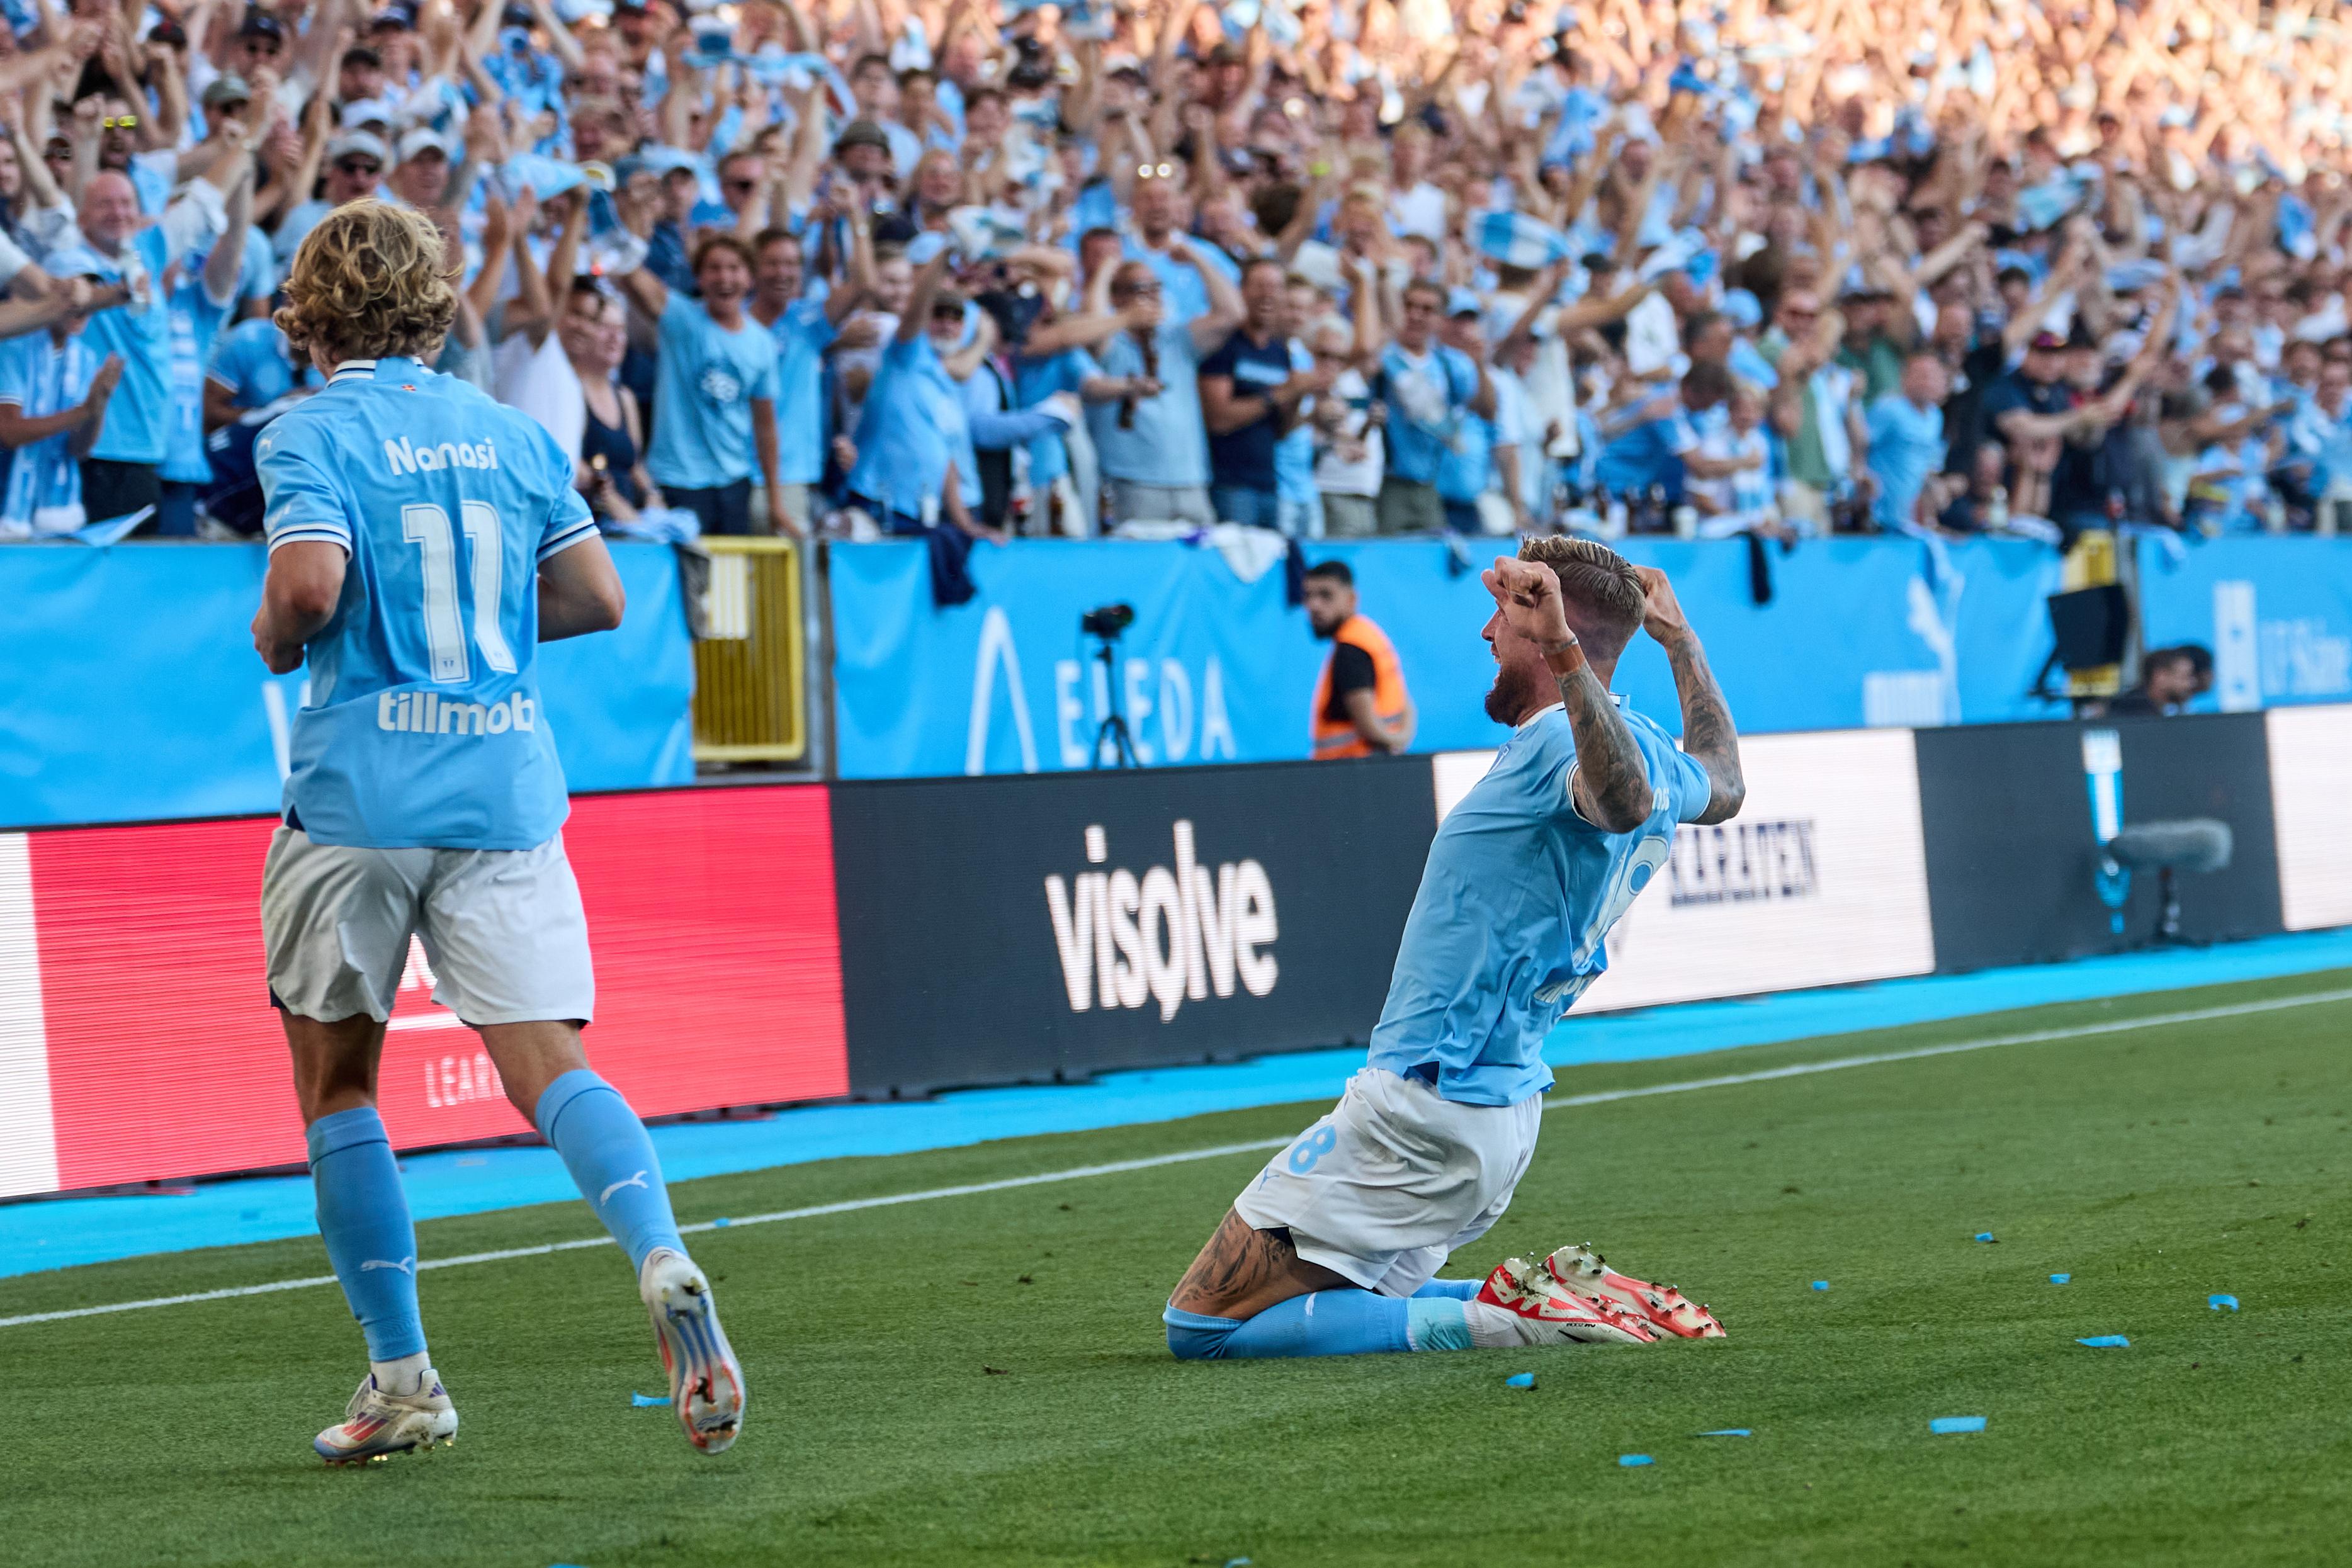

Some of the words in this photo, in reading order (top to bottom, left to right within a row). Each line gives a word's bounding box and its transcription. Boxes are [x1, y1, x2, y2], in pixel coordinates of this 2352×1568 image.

[384, 436, 497, 476] Nanasi
[401, 500, 517, 683] 11
[1054, 656, 1236, 769] ELEDA
[1045, 820, 1279, 1024] visolve
[1289, 1124, 1337, 1176] 8
